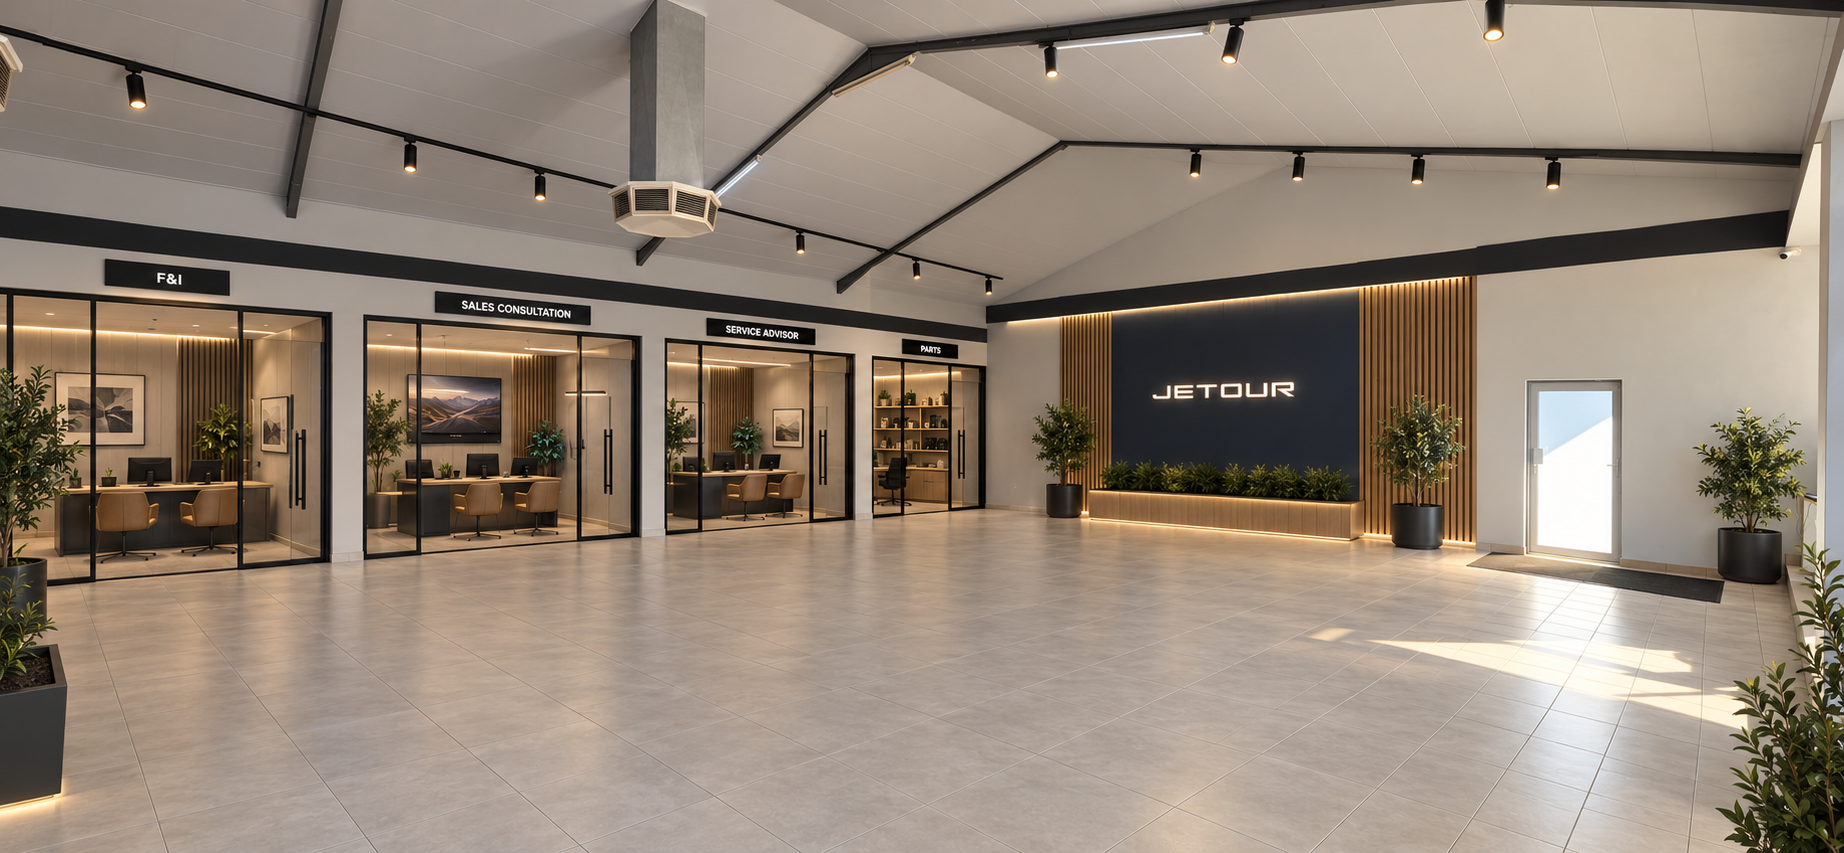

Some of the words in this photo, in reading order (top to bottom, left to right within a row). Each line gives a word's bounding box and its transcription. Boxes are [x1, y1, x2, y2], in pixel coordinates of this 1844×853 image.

[157, 272, 182, 285] F&I
[461, 300, 495, 312] SALES
[497, 303, 571, 319] CONSULTATION
[725, 325, 761, 337] SERVICE
[763, 329, 799, 340] ADVISOR
[920, 345, 941, 354] PARTS
[1152, 381, 1295, 400] JETOUR
